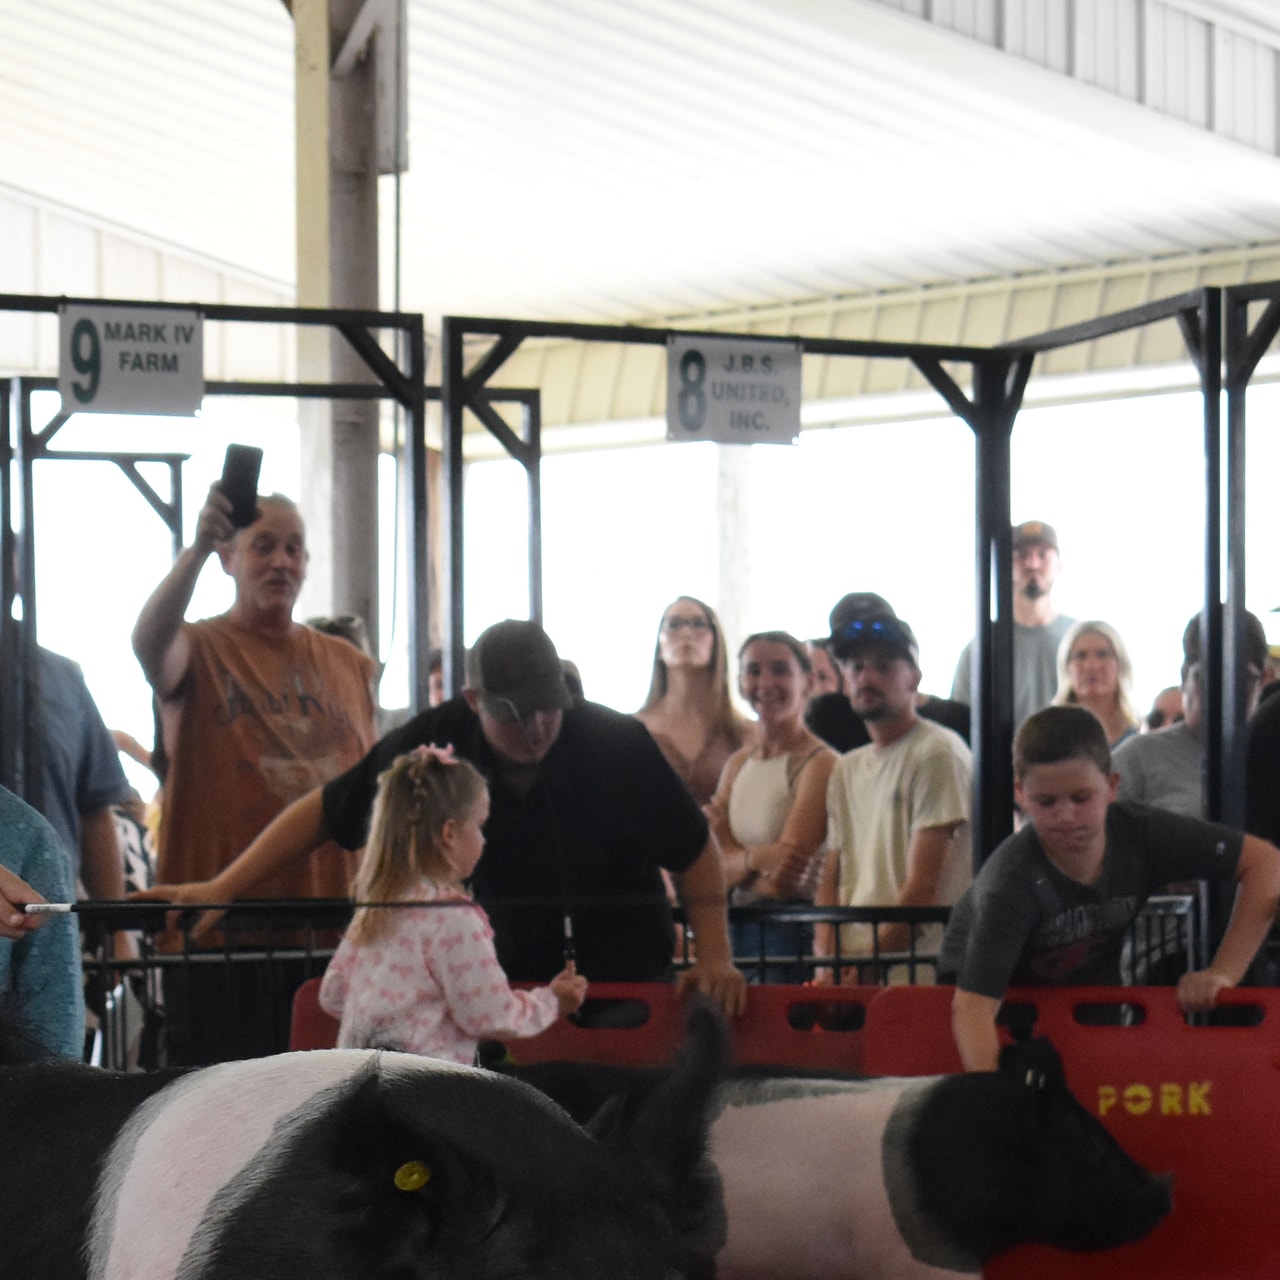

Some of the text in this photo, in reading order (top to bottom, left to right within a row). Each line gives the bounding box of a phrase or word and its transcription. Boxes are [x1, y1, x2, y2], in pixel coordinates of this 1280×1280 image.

[104, 322, 195, 344] MARK IV
[71, 317, 101, 404] 9
[119, 352, 179, 373] FARM
[678, 349, 706, 432] 8
[729, 410, 771, 431] INC.
[1098, 1080, 1213, 1117] PORK
